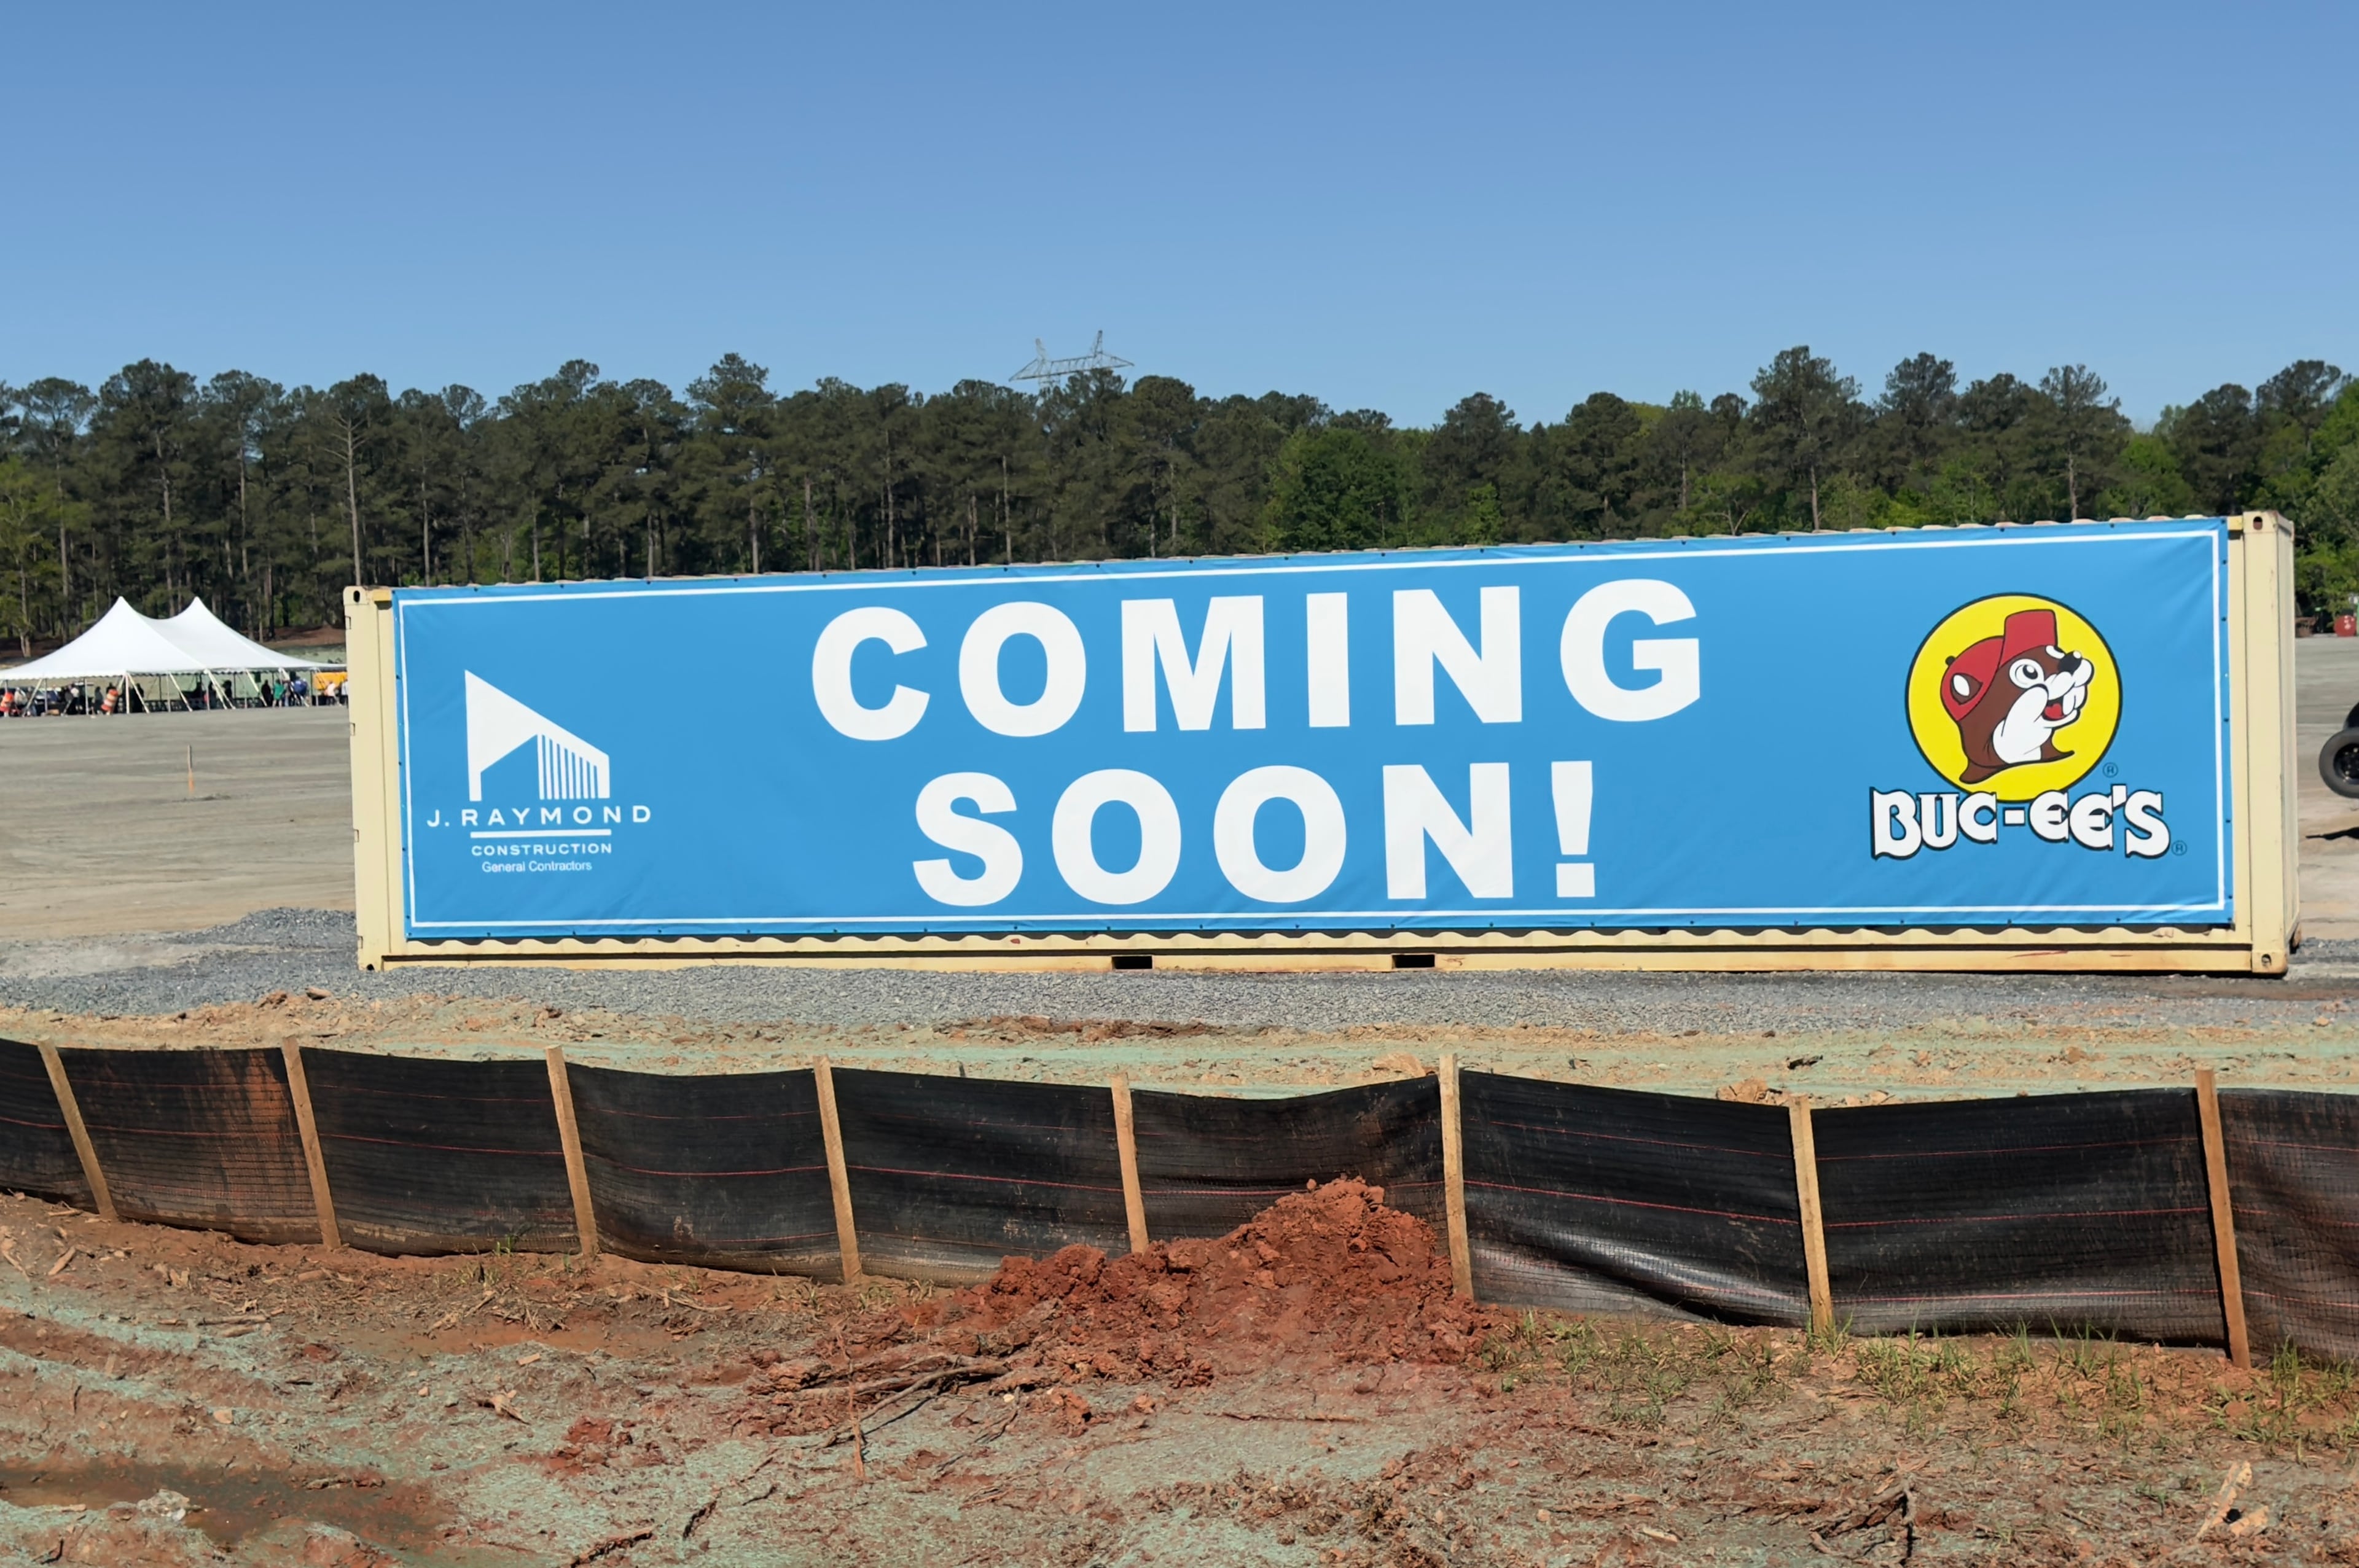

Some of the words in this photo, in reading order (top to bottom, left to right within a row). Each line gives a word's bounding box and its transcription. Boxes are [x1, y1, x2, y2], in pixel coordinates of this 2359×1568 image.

[812, 578, 1701, 742] COMING
[426, 809, 450, 827] J.
[461, 805, 651, 827] RAYMOND
[913, 760, 1596, 907] SOON!
[471, 843, 612, 856] CONSTRUCTION
[481, 861, 525, 873] General
[528, 860, 593, 872] Contractors
